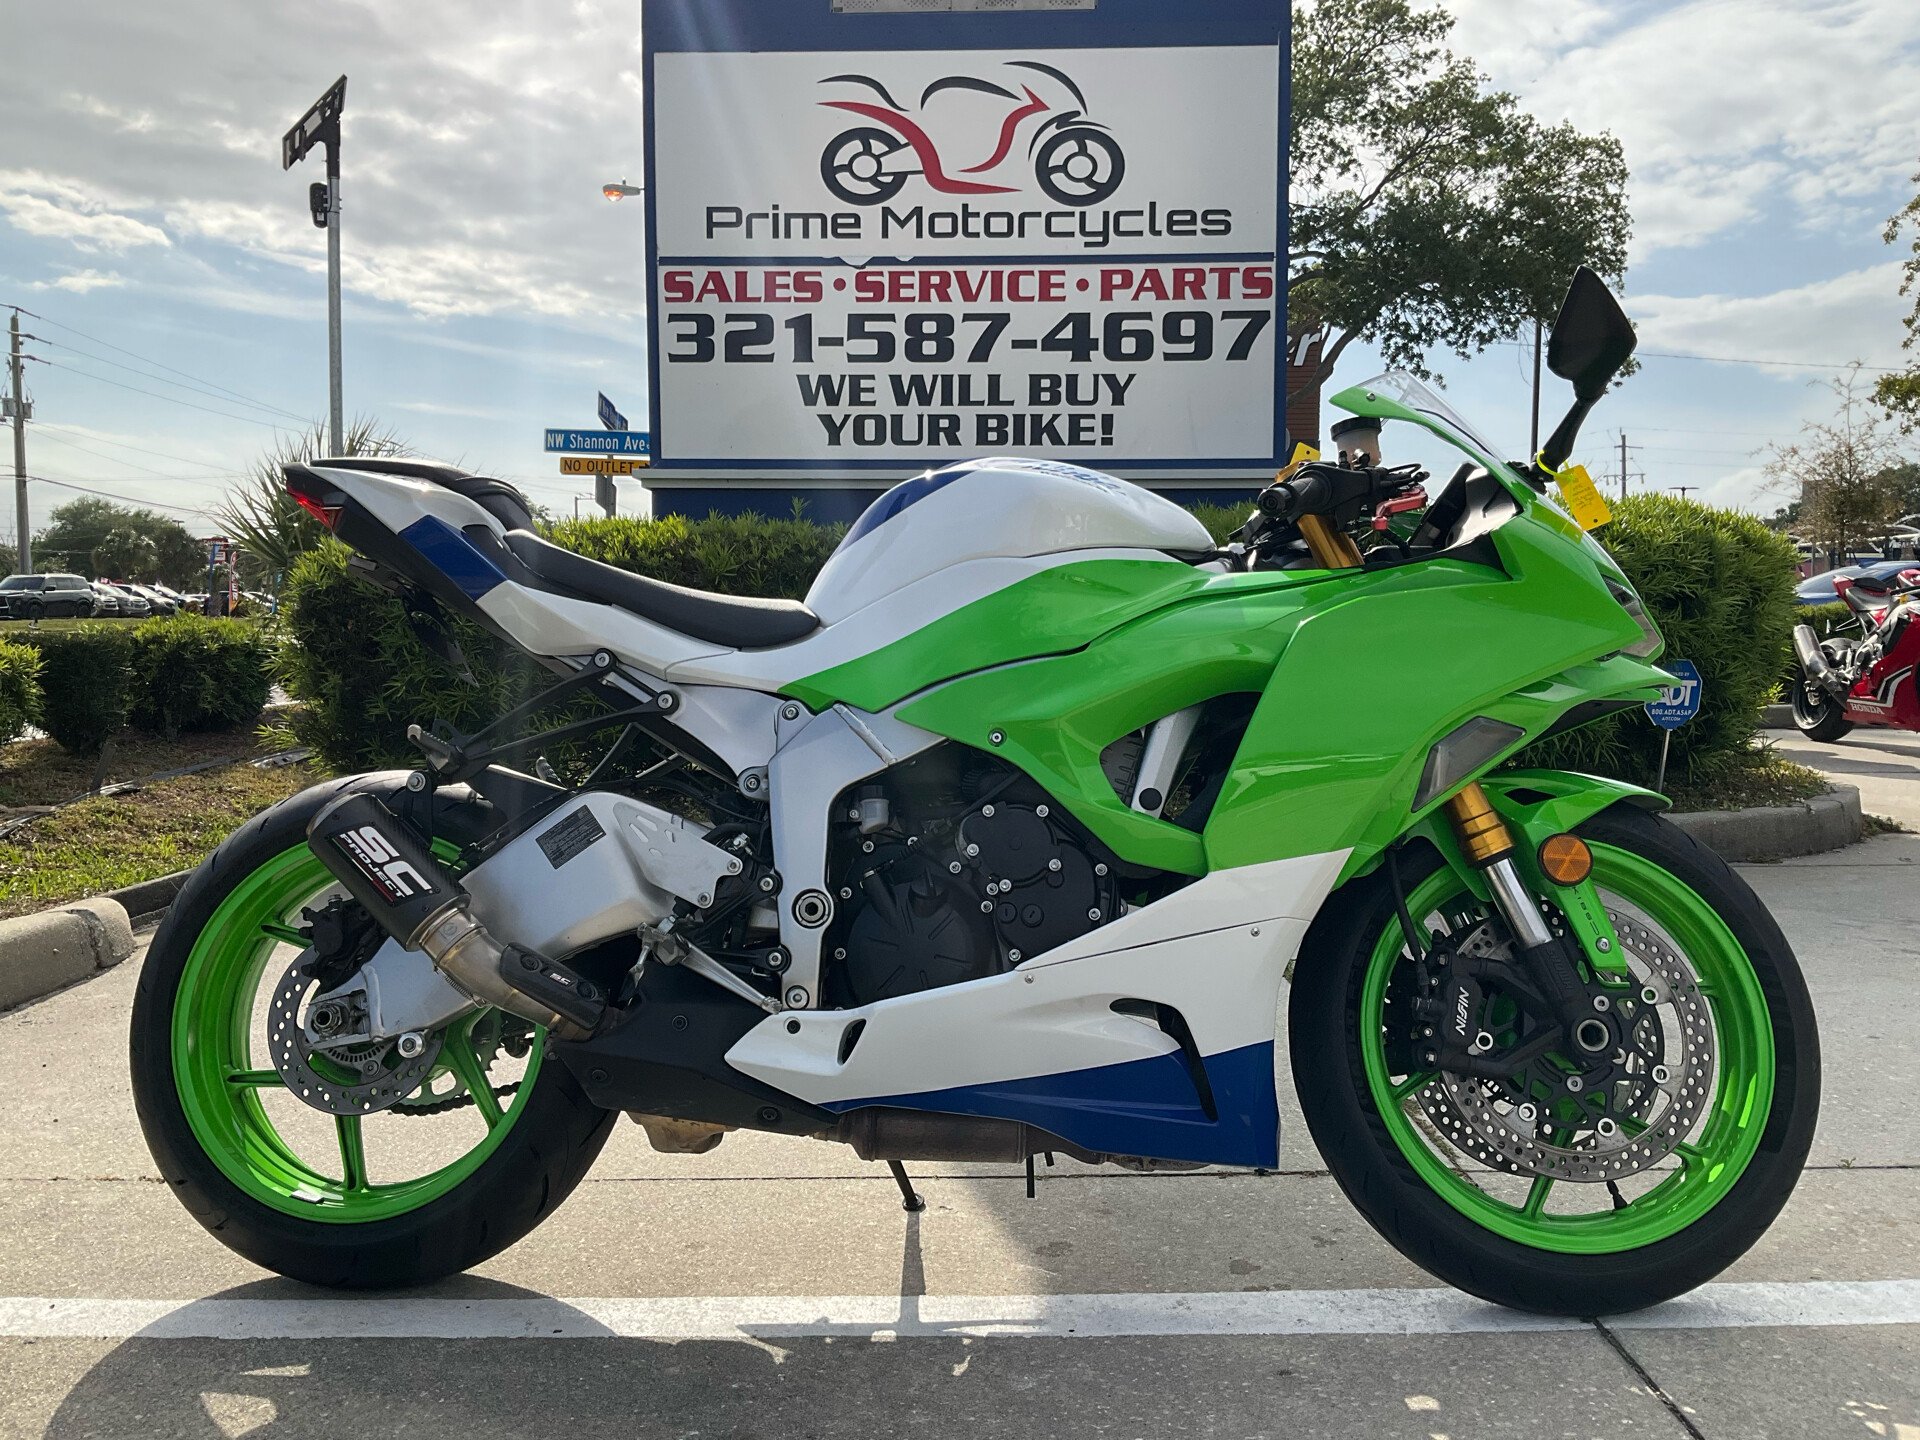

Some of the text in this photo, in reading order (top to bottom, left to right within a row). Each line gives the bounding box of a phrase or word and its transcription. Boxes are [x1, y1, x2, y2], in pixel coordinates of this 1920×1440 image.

[706, 201, 1232, 248] Prime Motorcycles
[663, 266, 1274, 304] SALES SERVICE PARTS
[667, 311, 1271, 363] 321-587-4697
[796, 373, 1137, 407] WE WILL BUY
[547, 433, 645, 450] NW Shannon Ave
[816, 413, 1114, 447] YOUR BIKE!
[563, 459, 635, 474] NO OUTLET
[1850, 702, 1885, 715] HONDA
[339, 833, 406, 898] PROJECT
[347, 826, 432, 896] SC
